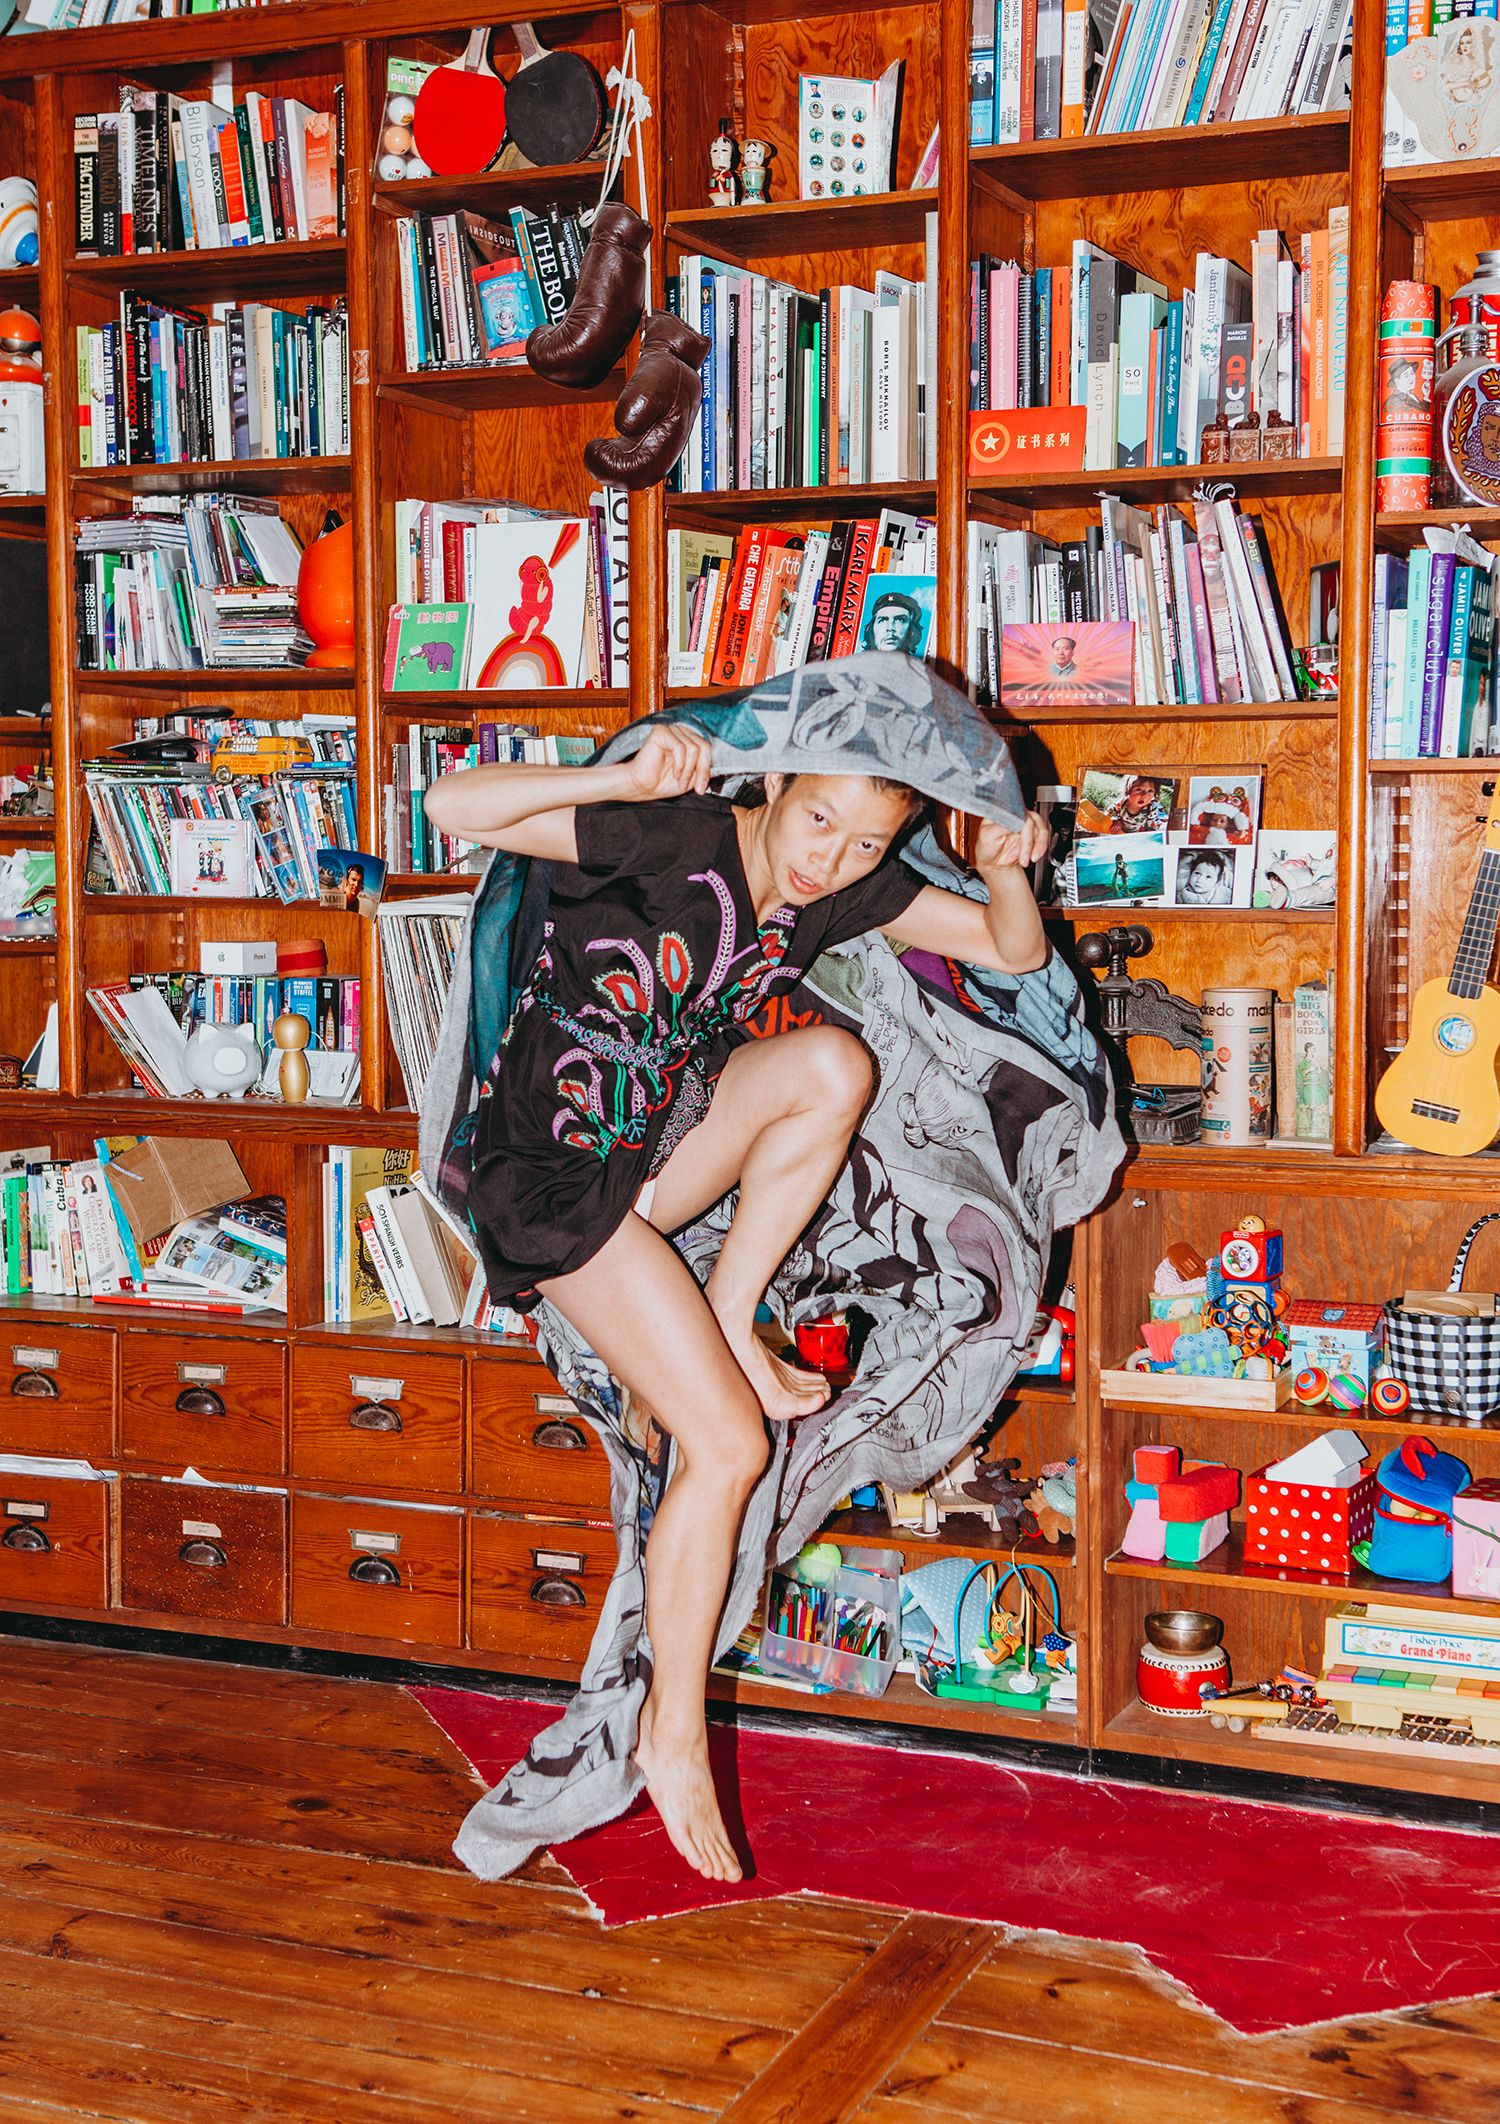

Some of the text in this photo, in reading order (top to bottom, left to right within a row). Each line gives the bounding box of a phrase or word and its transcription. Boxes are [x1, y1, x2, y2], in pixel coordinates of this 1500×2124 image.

[1279, 13, 1290, 30] Where
[1312, 10, 1324, 37] TRANSIT
[1328, 0, 1341, 30] ERUDA
[1251, 25, 1268, 68] WOMEN FICTION
[390, 72, 414, 85] PING
[1165, 69, 1181, 109] PABLO NERUDA
[1306, 84, 1317, 103] Earth
[186, 106, 206, 188] Bill Bryson
[101, 142, 116, 204] STALINGRAD
[141, 124, 156, 233] TIMELINES
[212, 166, 222, 197] 1000
[80, 157, 94, 241] FACTFINDER
[532, 226, 558, 277] THE
[1206, 269, 1218, 324] Janfamily
[1333, 253, 1348, 391] ART NOUVEAU
[126, 334, 134, 369] ALFRED
[1094, 313, 1107, 411] David Lynch
[104, 356, 113, 395] FRAMER
[1125, 369, 1141, 378] SO
[128, 371, 137, 425] HITCHCOCK
[106, 405, 115, 444] FRAMED
[1016, 432, 1071, 448] 证书系列
[718, 573, 727, 602] ERNESTO
[739, 544, 761, 610] CHE GUEVARA
[839, 533, 869, 634] KARL MARX
[813, 566, 840, 647] Empire
[1195, 605, 1204, 632] GIRL
[1453, 582, 1467, 654] JAMIE OLIVER
[709, 622, 718, 653] GUEVARA
[725, 612, 738, 656] ANDERSON
[732, 613, 747, 658] JON LEE
[789, 624, 802, 667] COMPENDIUM
[1425, 576, 1446, 683] sugar club
[1372, 601, 1383, 737] Enchanted Broccoli Forest
[1423, 693, 1431, 712] peter
[1301, 1001, 1320, 1009] BIG
[871, 1013, 885, 1043] BELLA
[886, 1034, 898, 1052] DEL
[1297, 1027, 1325, 1035] GIRLS
[383, 1149, 411, 1172] 你好
[367, 1232, 385, 1269] SPANISH
[376, 1204, 404, 1269] 501 SPANISH VERBS
[1401, 1644, 1471, 1662] Grand Piano
